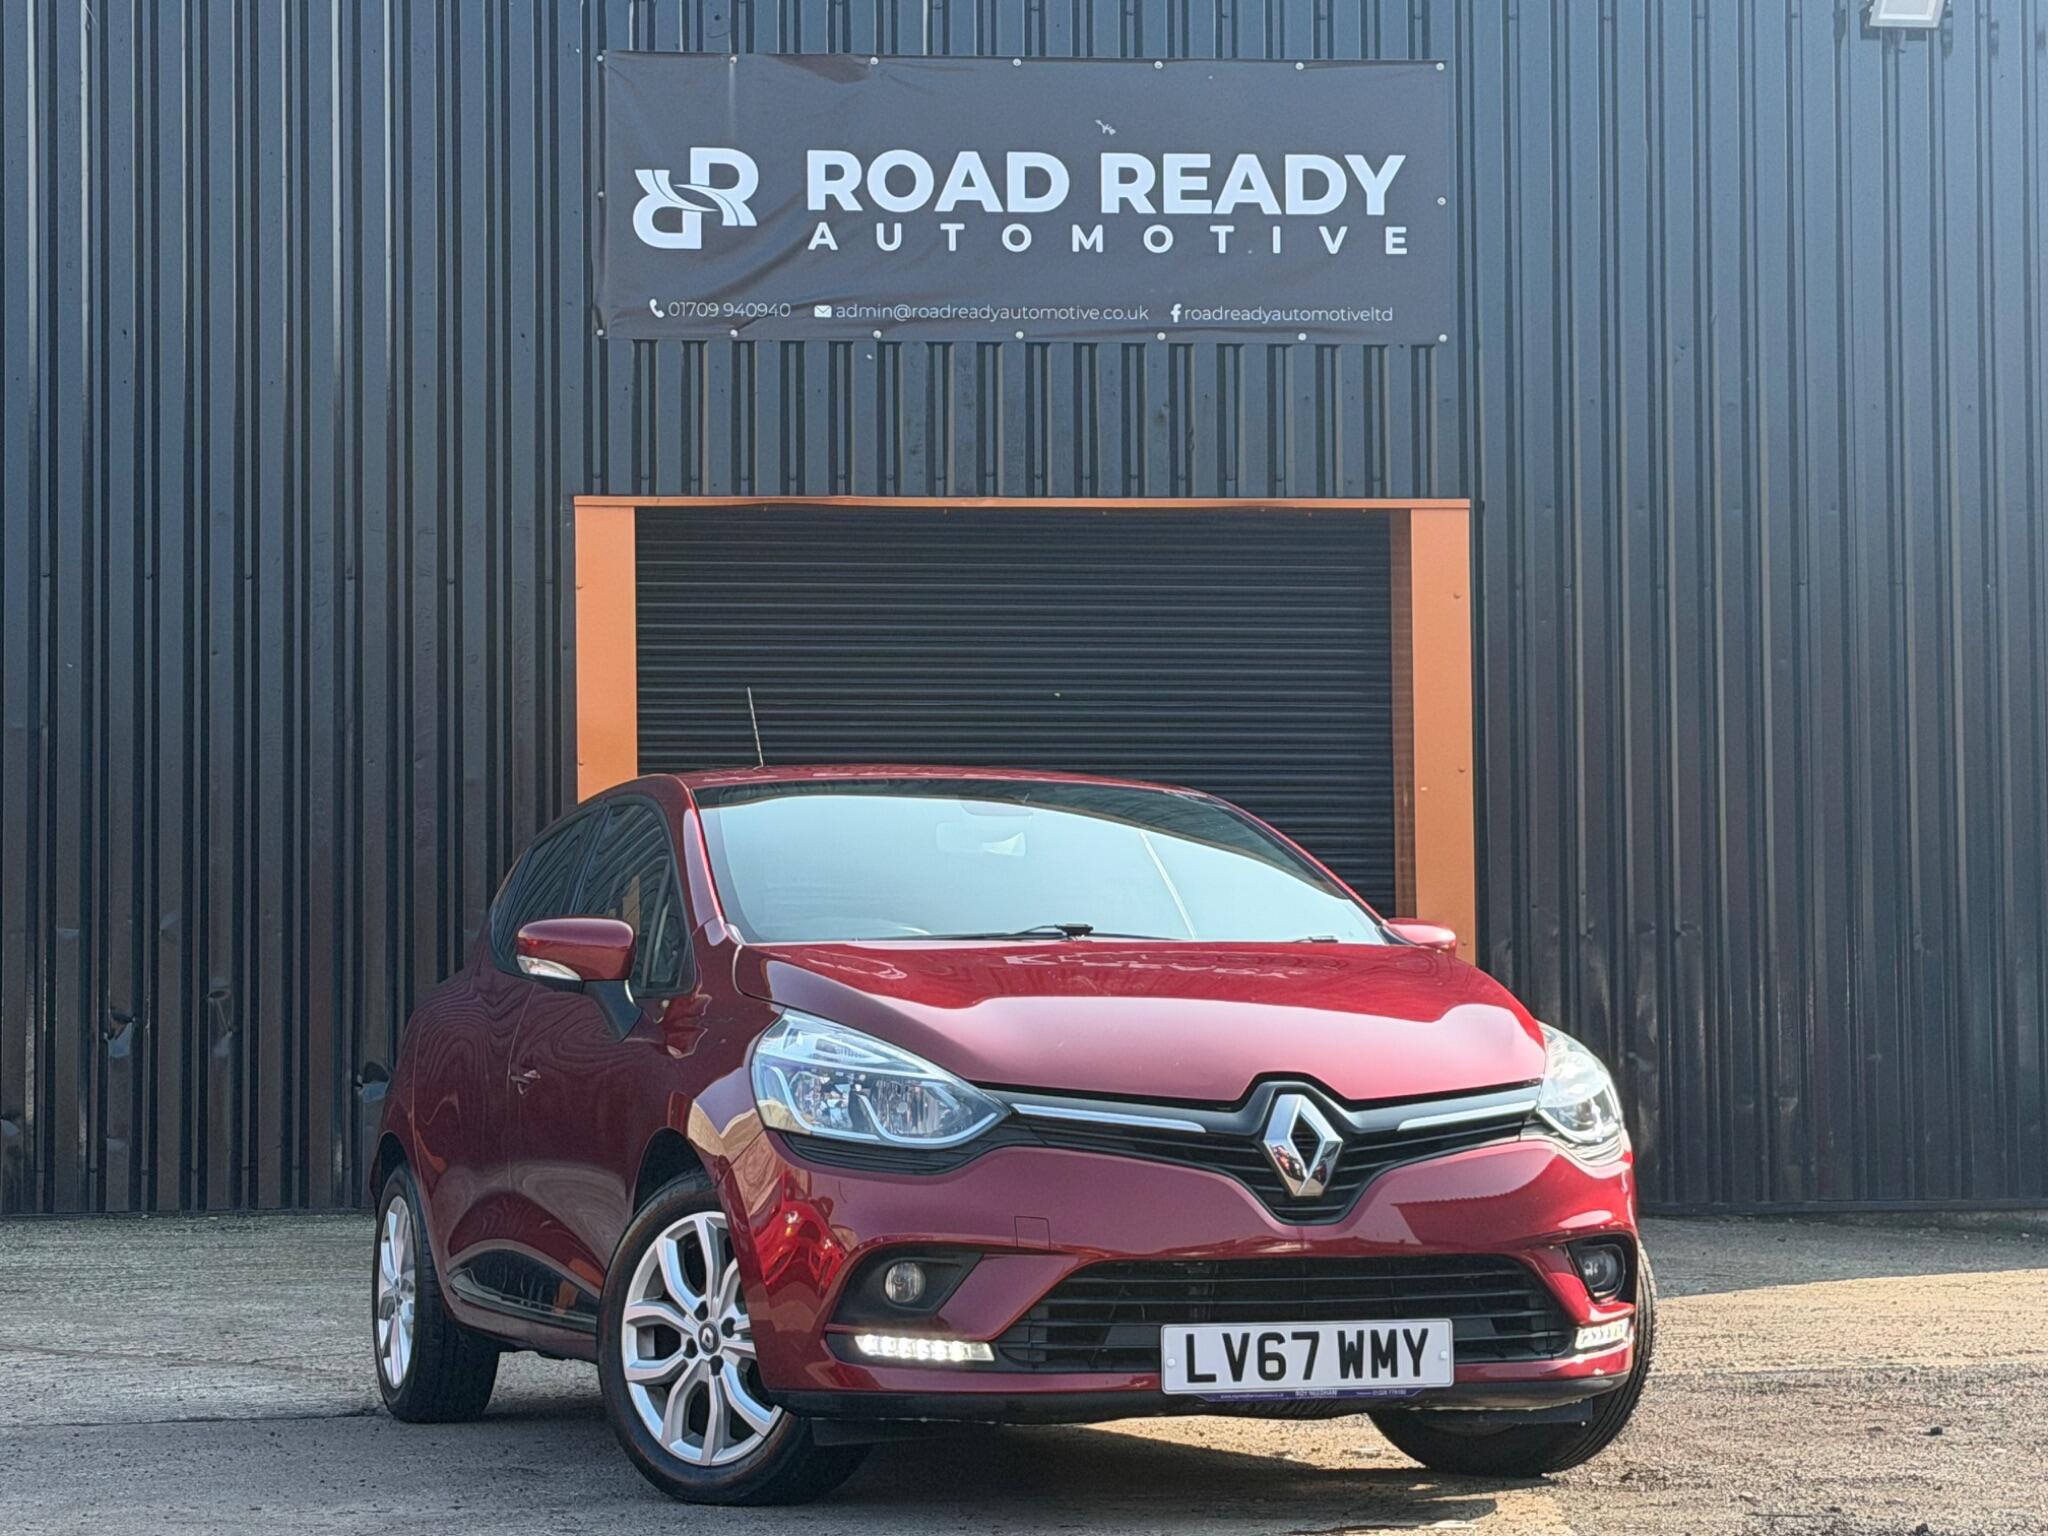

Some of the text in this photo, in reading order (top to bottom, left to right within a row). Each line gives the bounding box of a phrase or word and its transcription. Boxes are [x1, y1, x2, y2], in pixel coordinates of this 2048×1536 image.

[807, 150, 1406, 215] ROAD READY
[808, 222, 1407, 254] AUTOMOTIVE
[669, 302, 790, 317] 01709 940940
[836, 304, 1148, 322] admin@roadreadyautomotive.co.uk
[1185, 306, 1392, 324] roadreadyautomotiveltd
[1187, 1329, 1428, 1382] LV67 WMY
